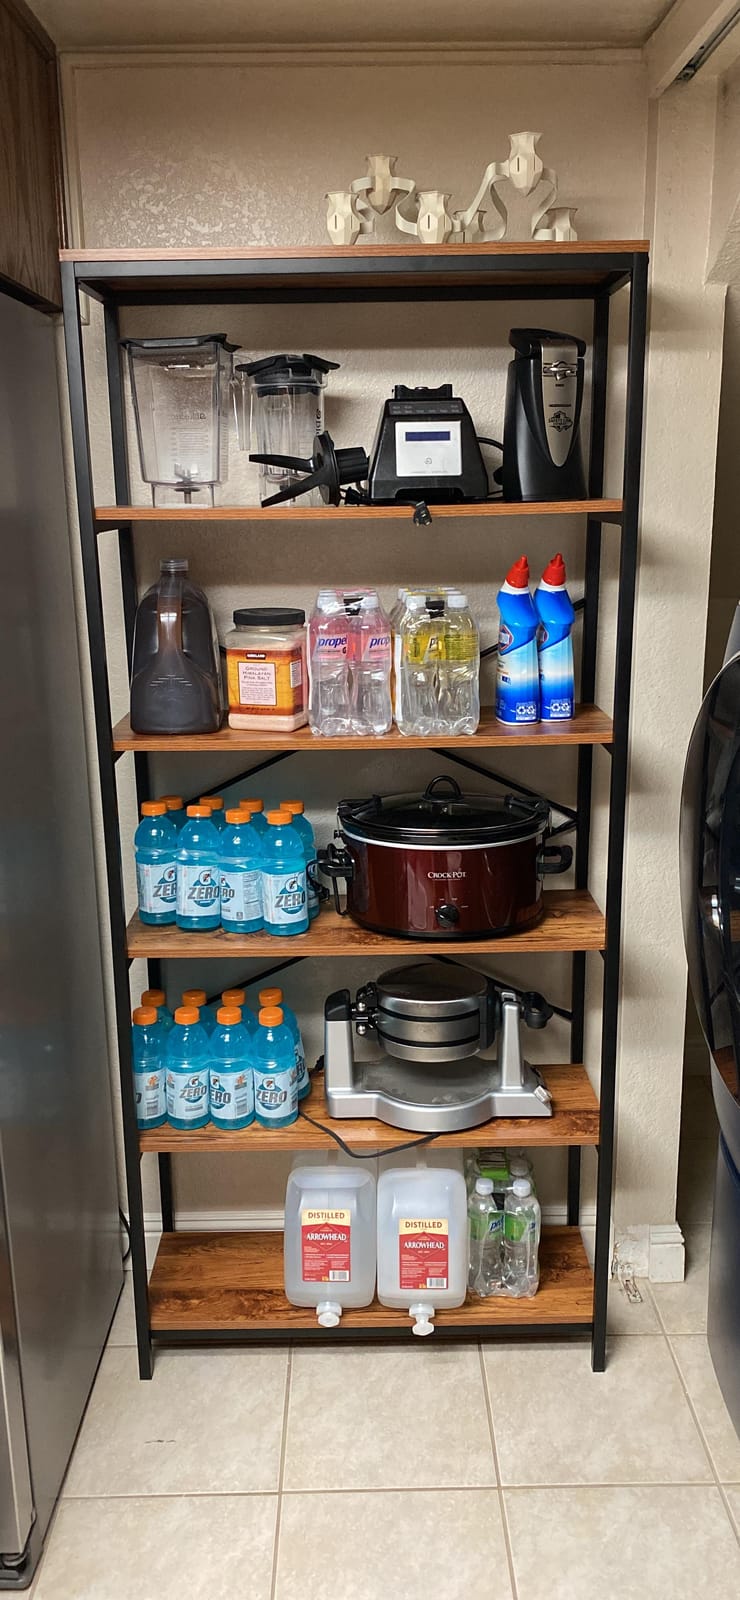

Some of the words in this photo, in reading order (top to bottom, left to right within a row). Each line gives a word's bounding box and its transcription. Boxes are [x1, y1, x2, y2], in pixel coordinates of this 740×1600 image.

[152, 883, 176, 898] ZER
[187, 885, 220, 900] ZERO
[274, 891, 306, 908] ZERO
[179, 1085, 207, 1098] ZERO
[210, 1089, 231, 1104] ERO
[255, 1089, 287, 1103] ZERO
[308, 1211, 345, 1219] DISTILLED
[405, 1221, 443, 1229] DISTILLED
[306, 1233, 347, 1241] ARROWHEAD
[404, 1241, 445, 1249] ARROWHEAD
